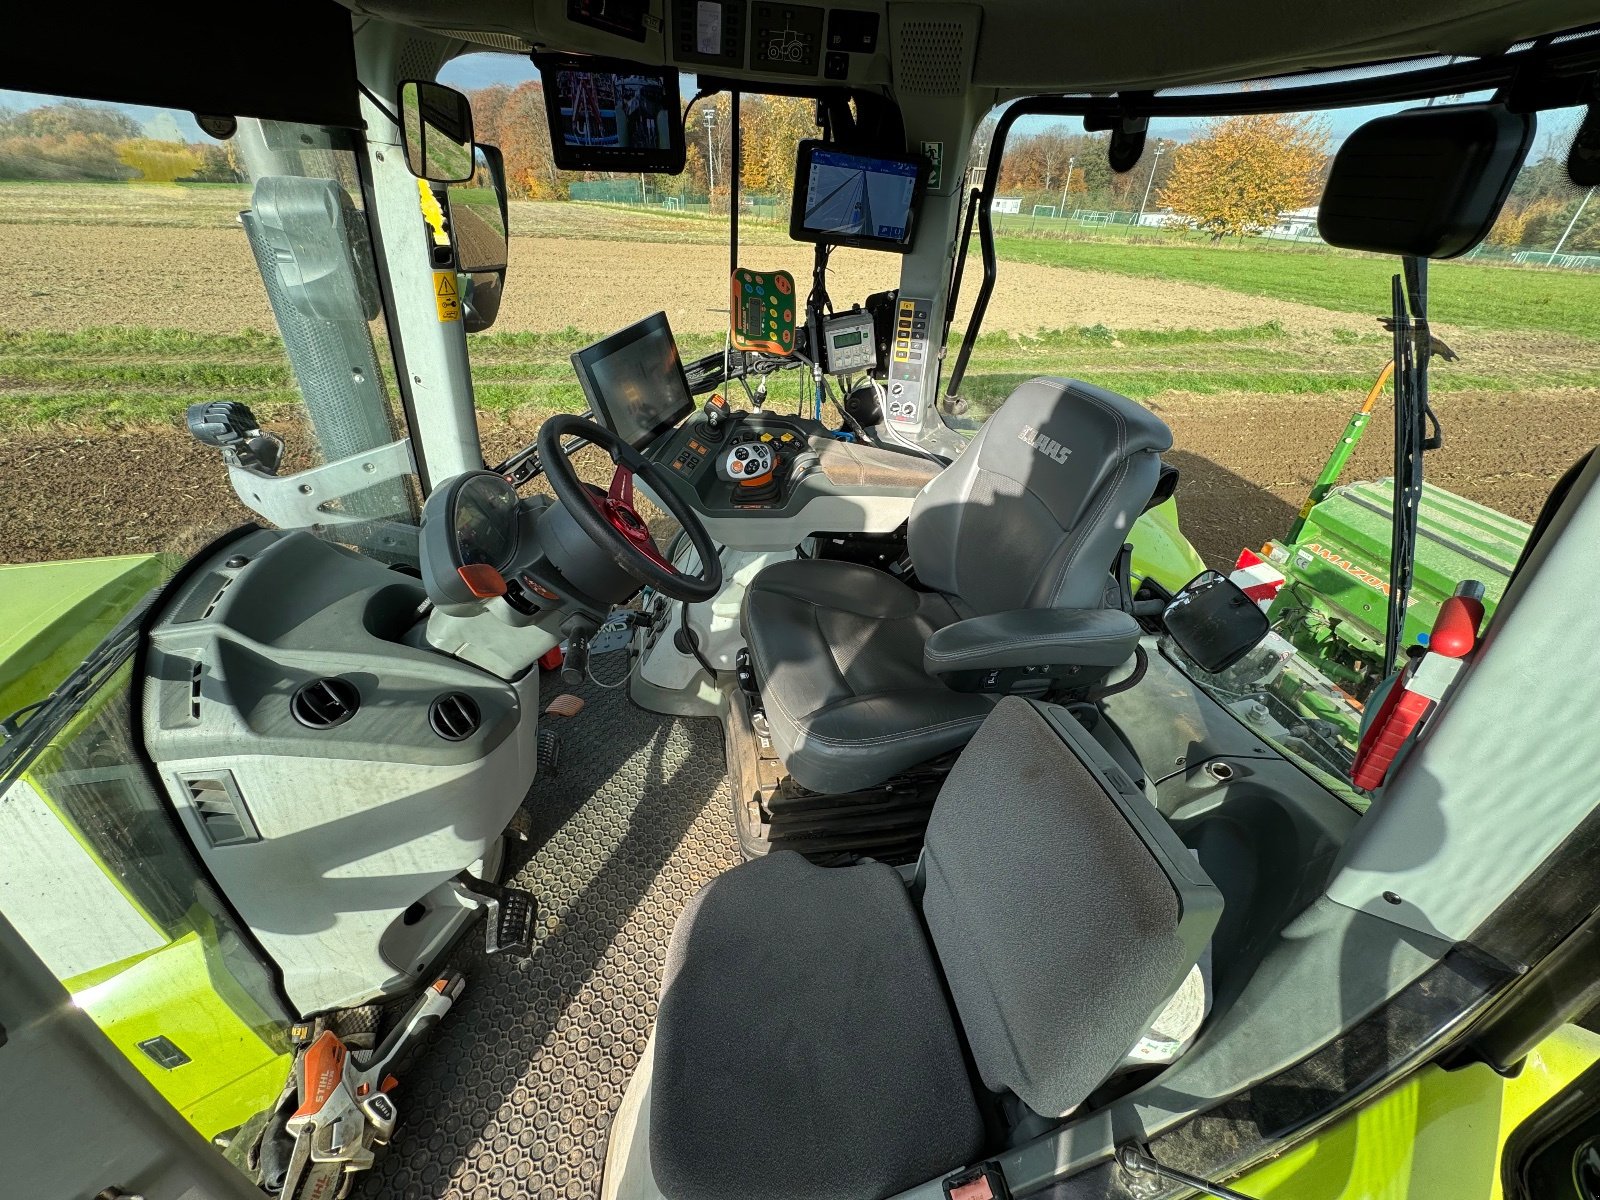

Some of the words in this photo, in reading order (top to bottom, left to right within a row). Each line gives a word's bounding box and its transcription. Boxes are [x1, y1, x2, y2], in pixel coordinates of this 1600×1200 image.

[1017, 424, 1073, 465] CLAAS
[1296, 557, 1308, 570] CE
[1302, 543, 1391, 598] AMAZON
[315, 1069, 330, 1103] STIHL
